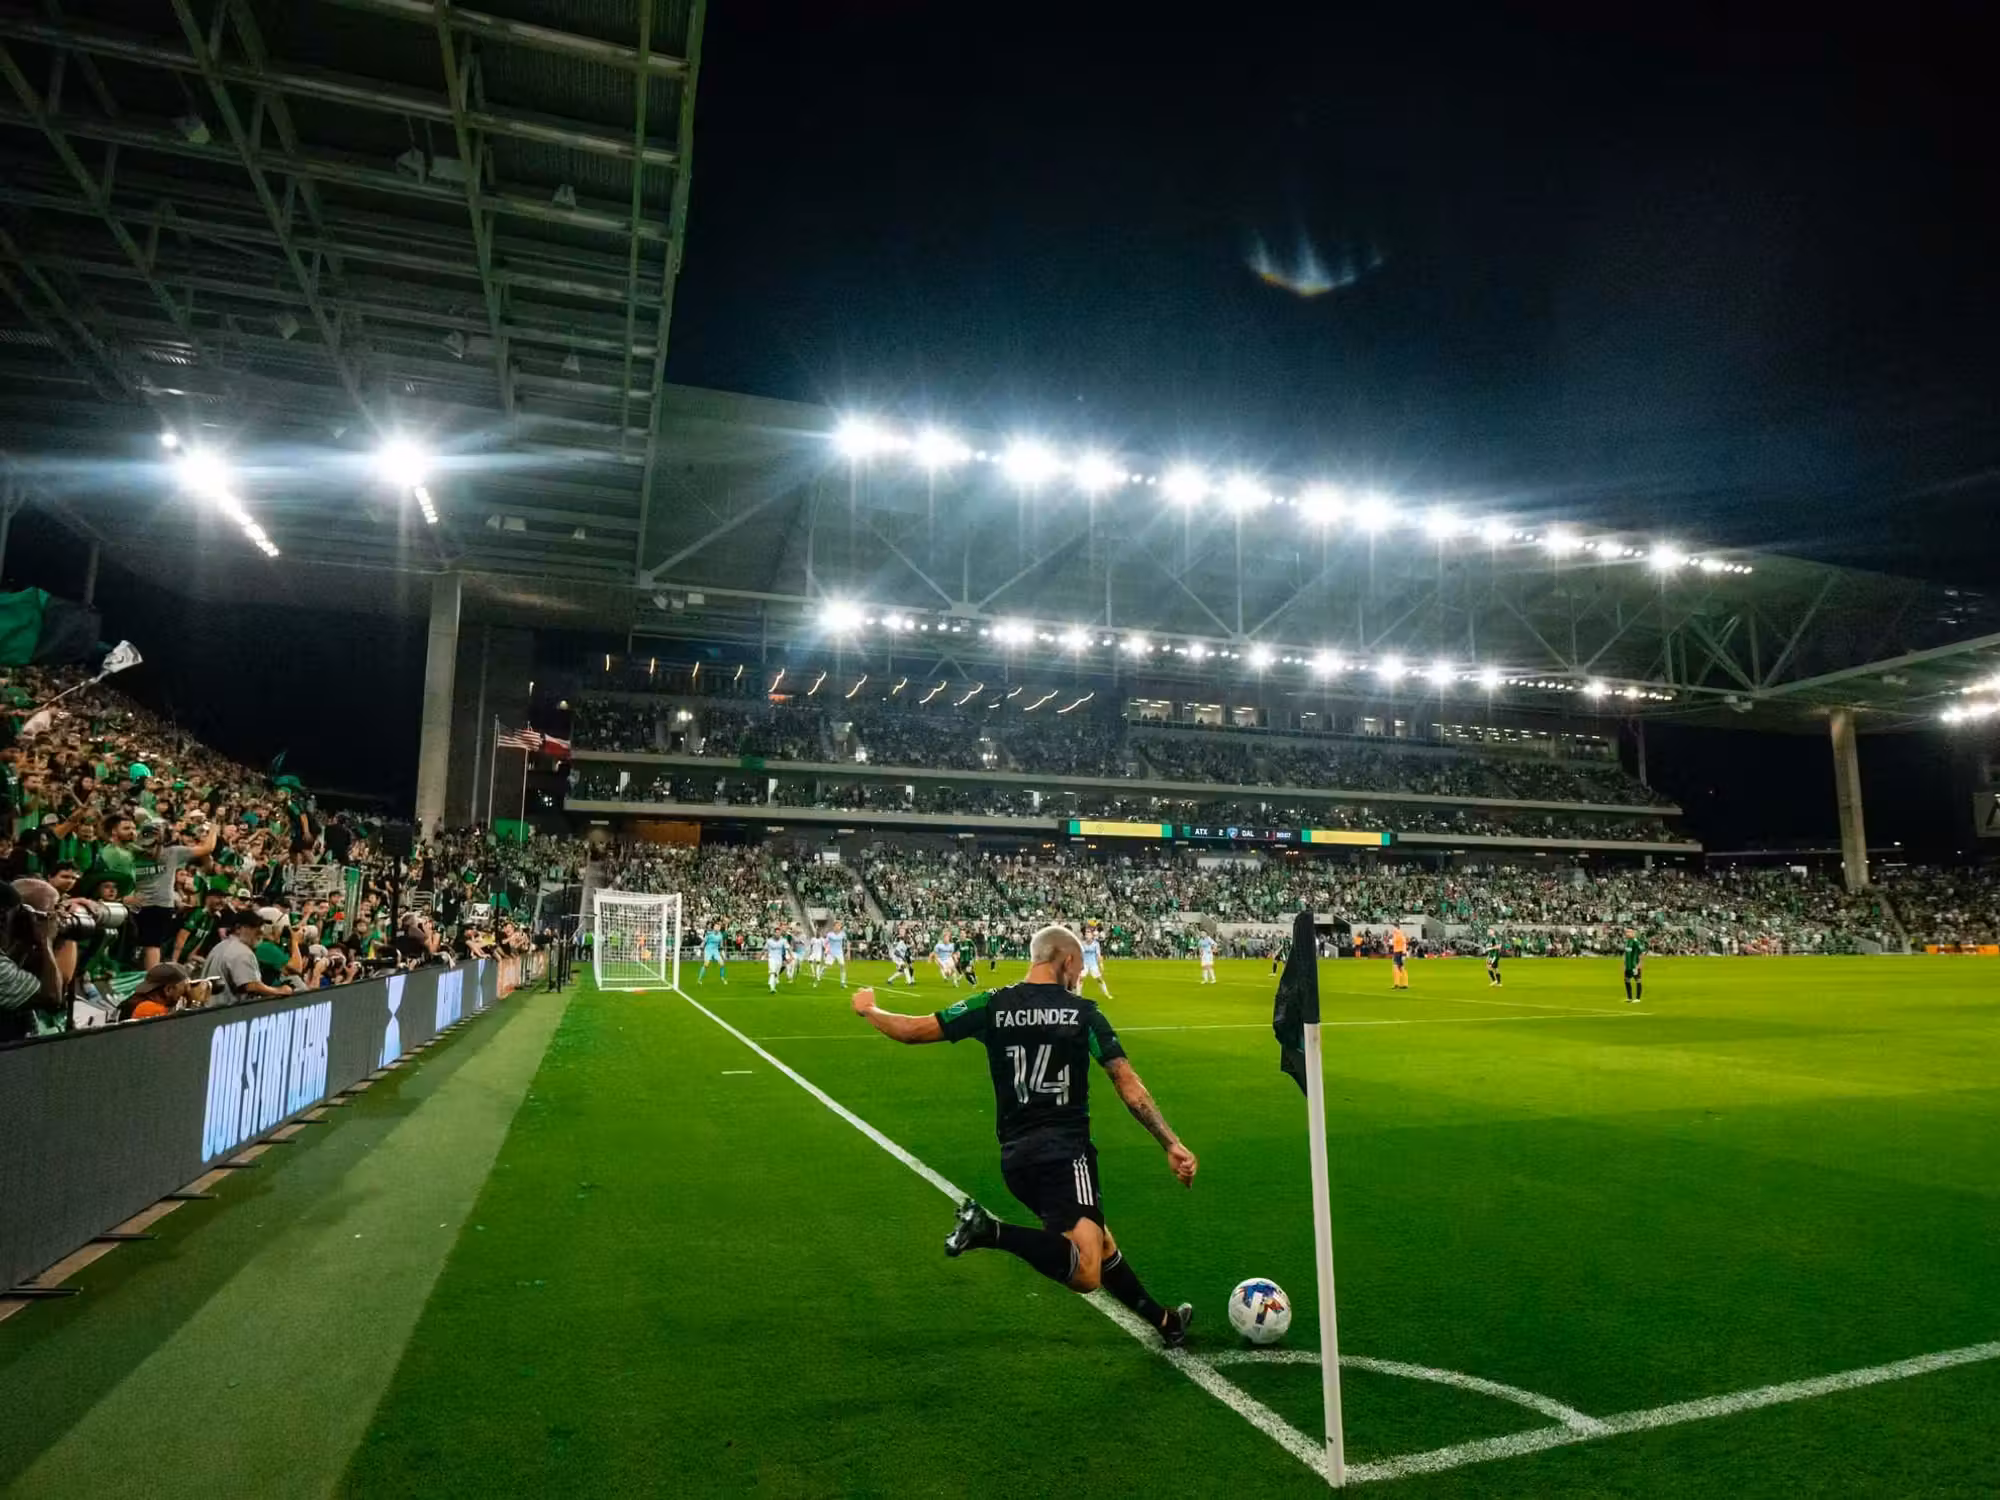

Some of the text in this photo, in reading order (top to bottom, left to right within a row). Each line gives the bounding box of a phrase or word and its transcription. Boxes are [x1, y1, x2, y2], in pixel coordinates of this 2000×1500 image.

[1194, 828, 1208, 836] ATX
[995, 1008, 1080, 1028] FAGUNDEZ
[202, 1020, 248, 1164] OUR
[240, 1011, 294, 1142] STORY
[1004, 1043, 1071, 1106] 14
